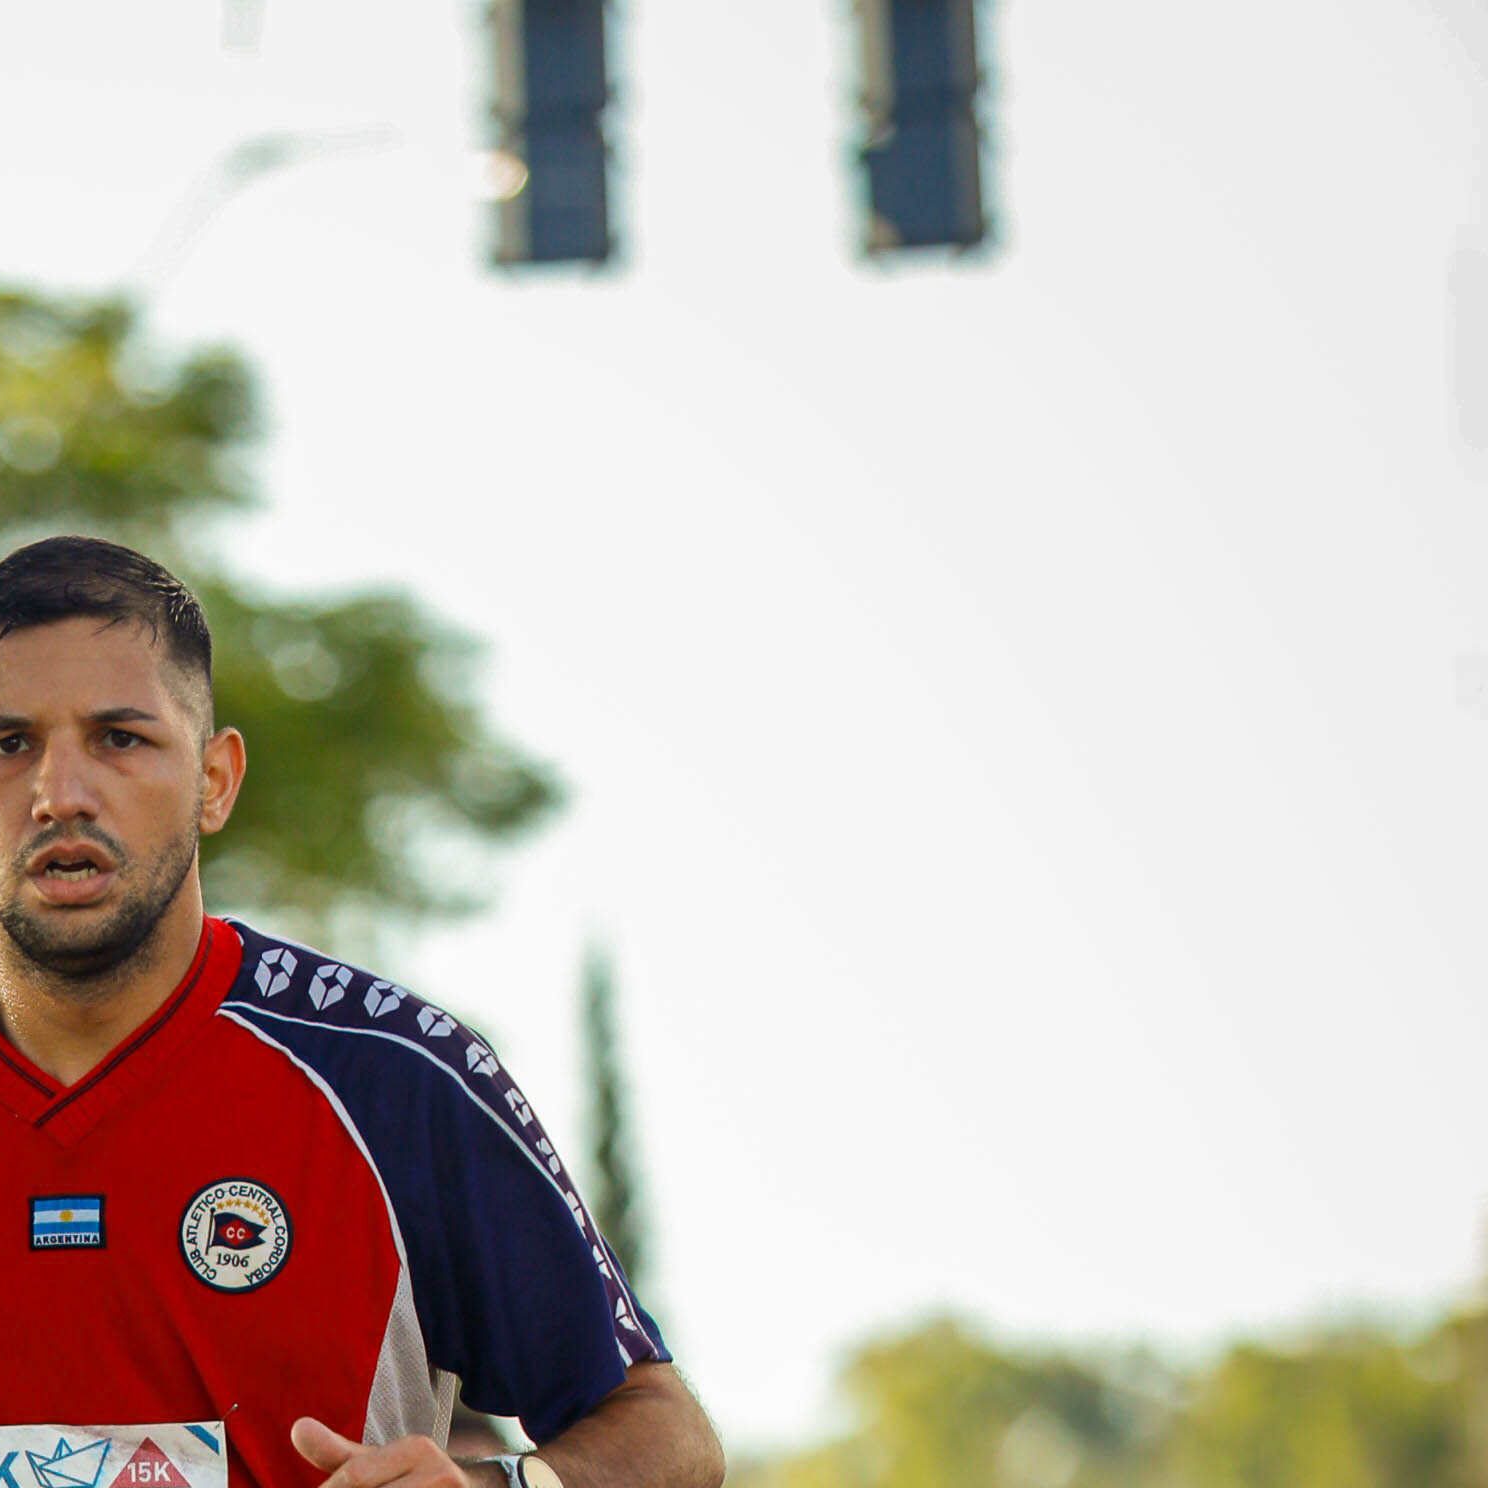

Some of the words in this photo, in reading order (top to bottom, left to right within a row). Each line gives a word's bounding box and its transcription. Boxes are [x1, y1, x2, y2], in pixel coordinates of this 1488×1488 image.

[186, 1188, 225, 1248] ATLETICO
[228, 1185, 282, 1226] CENTRAL
[34, 1233, 100, 1246] ARGENTINA
[244, 1225, 286, 1285] CORDOBA
[190, 1248, 217, 1281] CLUB
[215, 1252, 250, 1268] 1906
[126, 1461, 172, 1484] 15K
